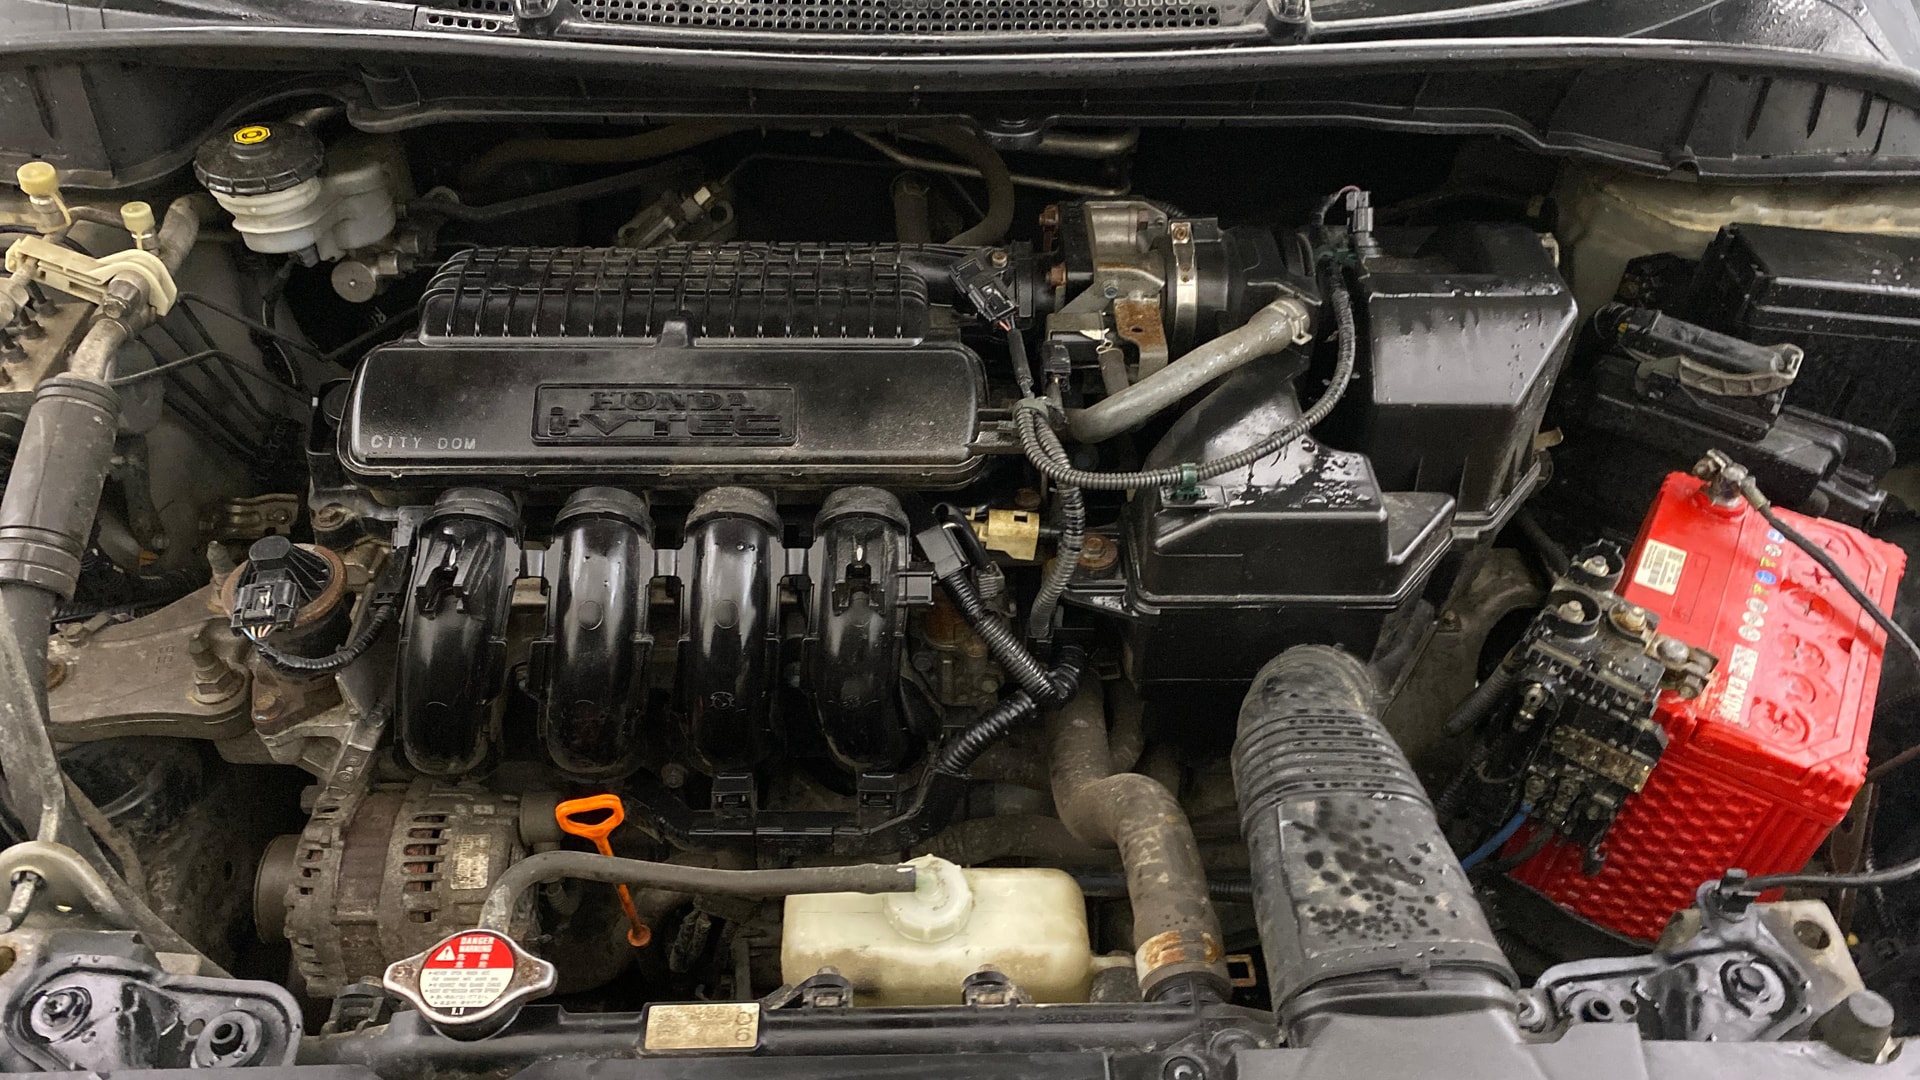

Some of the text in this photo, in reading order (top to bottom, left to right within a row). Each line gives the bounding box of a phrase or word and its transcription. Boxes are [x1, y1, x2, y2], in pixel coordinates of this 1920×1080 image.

[589, 391, 756, 411] HONDA
[370, 434, 476, 450] CITY DOM
[460, 937, 495, 945] DANGER
